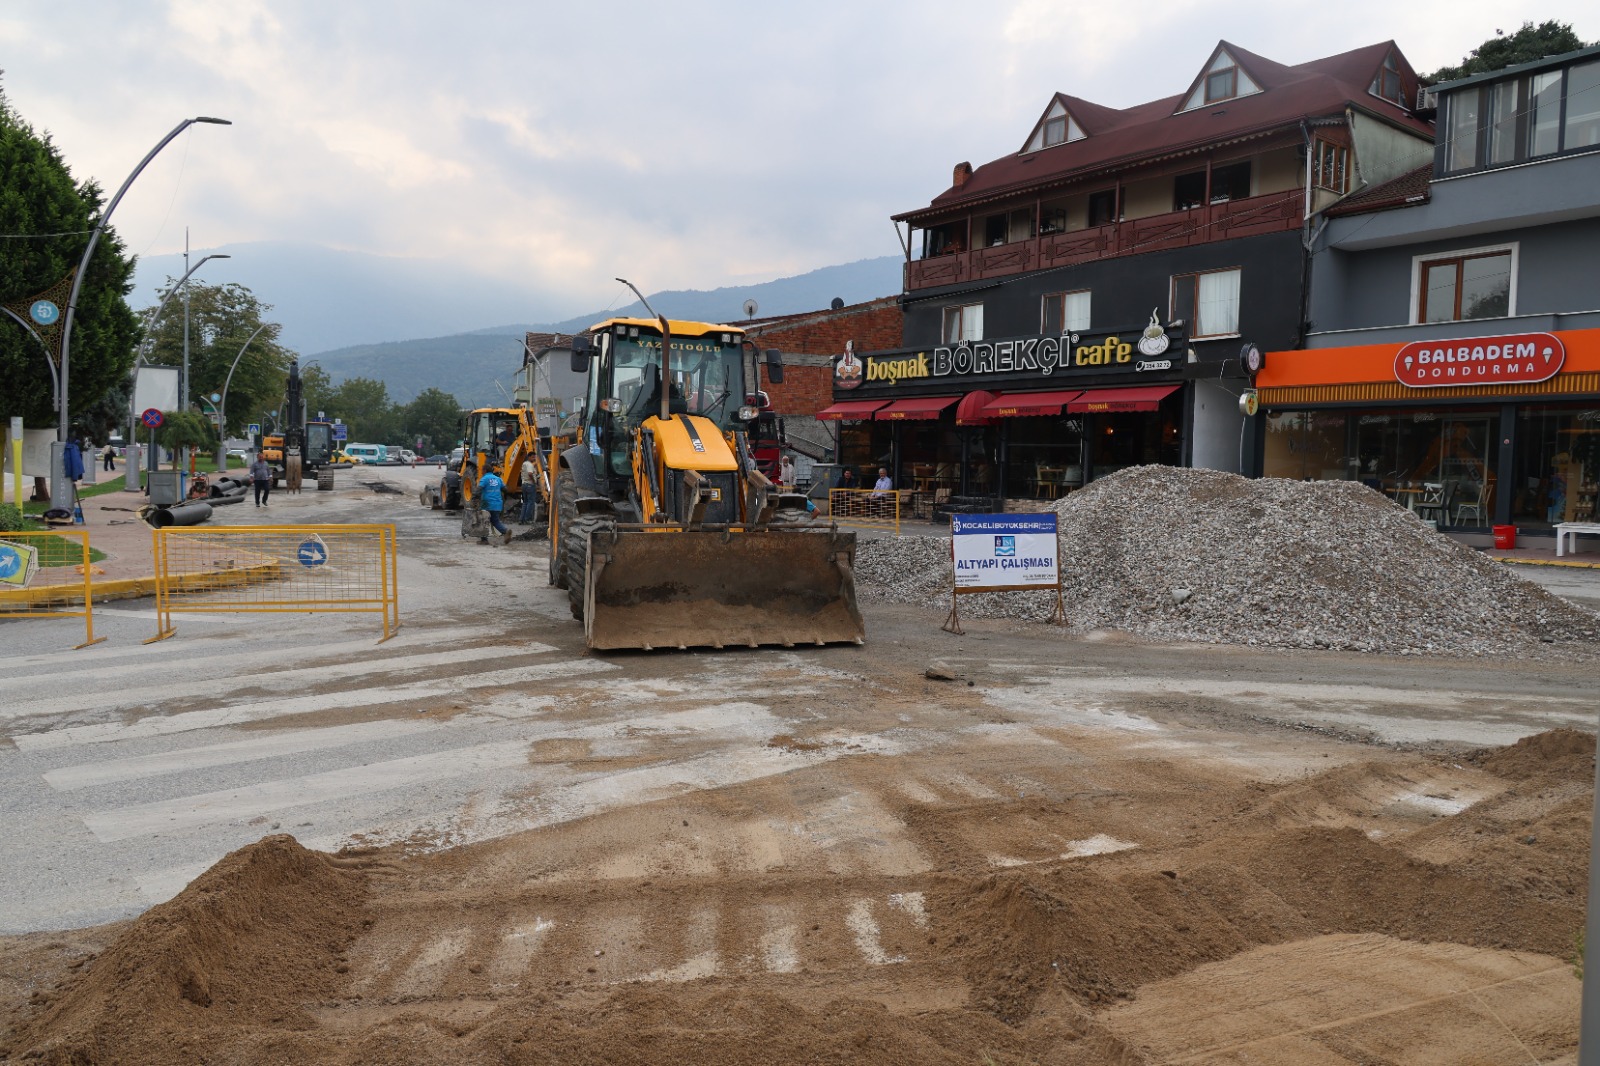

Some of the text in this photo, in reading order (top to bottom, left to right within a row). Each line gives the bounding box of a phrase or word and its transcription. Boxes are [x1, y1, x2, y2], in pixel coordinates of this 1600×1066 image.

[637, 340, 721, 353] YAZCIOĞLU
[1418, 342, 1535, 364] BALBADEM
[866, 330, 1132, 385] boşnak BÖREKÇİ cafe
[1417, 362, 1534, 379] DONDURMA
[957, 557, 1053, 571] ALTYAPI ÇALIŞMASI
